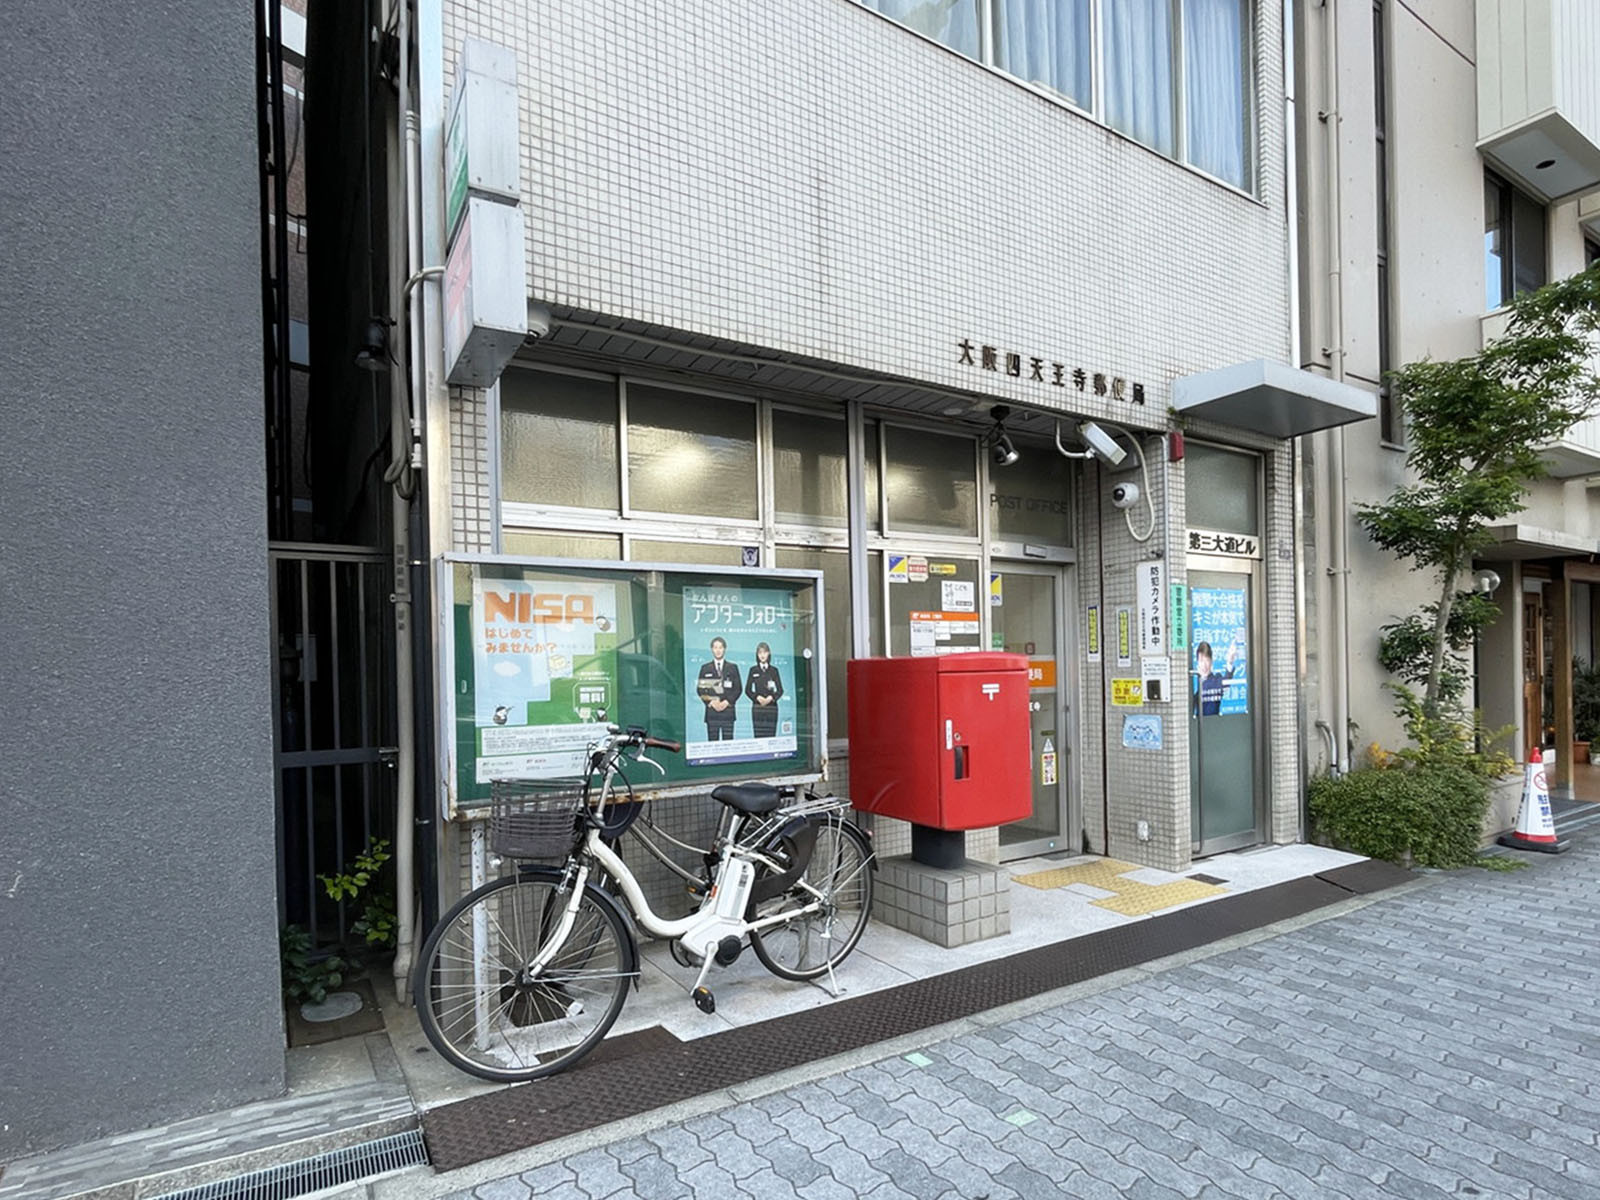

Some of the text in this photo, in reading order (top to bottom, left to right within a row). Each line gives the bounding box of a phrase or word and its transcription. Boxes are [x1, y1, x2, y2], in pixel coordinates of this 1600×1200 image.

[958, 339, 1145, 406] 大阪四天王寺郵便局
[990, 494, 1021, 509] POST
[1189, 532, 1256, 555] 第三大道ビル
[484, 591, 594, 624] NISA
[691, 604, 786, 625] アフターフォロー
[1150, 566, 1160, 646] 防犯カメラ作動中
[485, 628, 533, 639] はじめて
